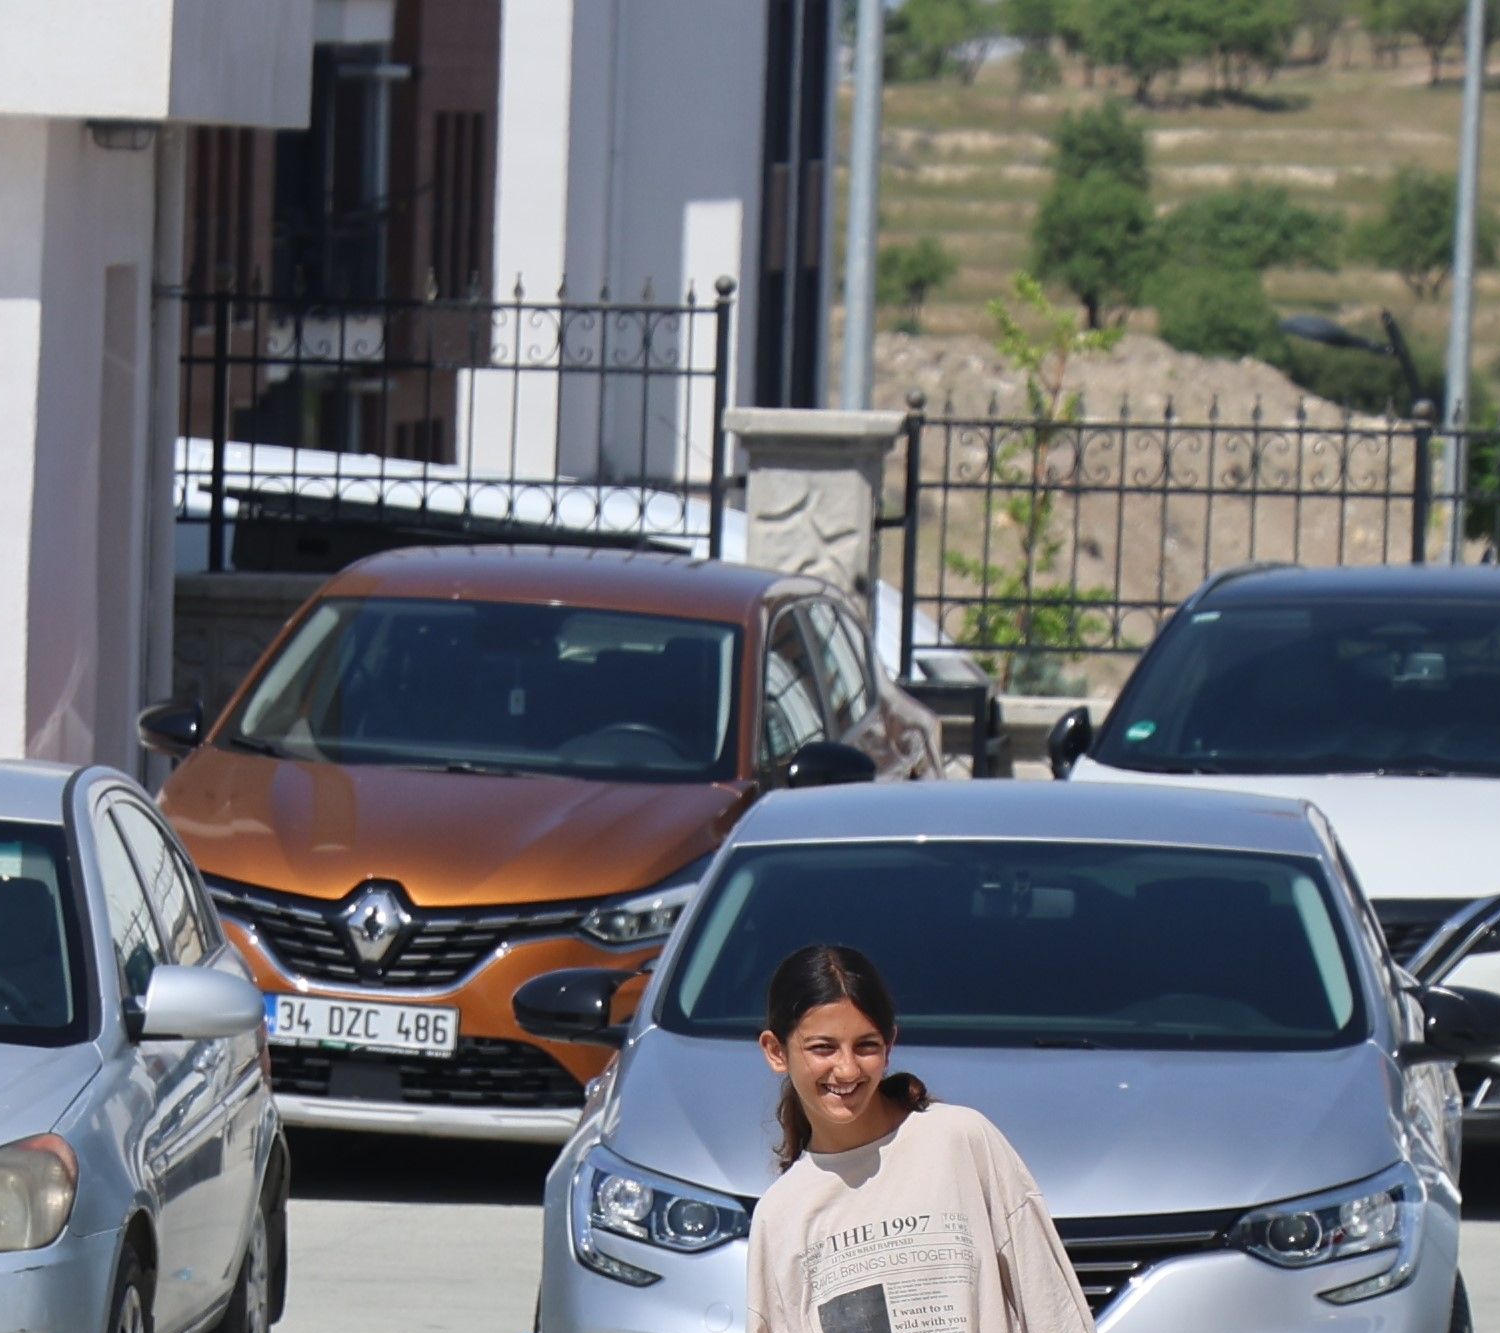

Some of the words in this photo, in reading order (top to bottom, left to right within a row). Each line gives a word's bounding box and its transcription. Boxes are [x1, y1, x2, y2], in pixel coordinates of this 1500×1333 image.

[280, 1002, 312, 1034] 34
[328, 1006, 380, 1038] DZC
[397, 1011, 448, 1044] 486
[826, 1222, 876, 1252] THE
[880, 1214, 931, 1238] 1997
[811, 1270, 838, 1292] RAVEL
[840, 1256, 887, 1278] BRINGS
[889, 1251, 908, 1266] US
[911, 1248, 974, 1264] TOGETHER
[895, 1317, 919, 1331] wild
[921, 1316, 946, 1328] with
[948, 1316, 967, 1328] you
[900, 1306, 927, 1317] want
[929, 1304, 941, 1314] to
